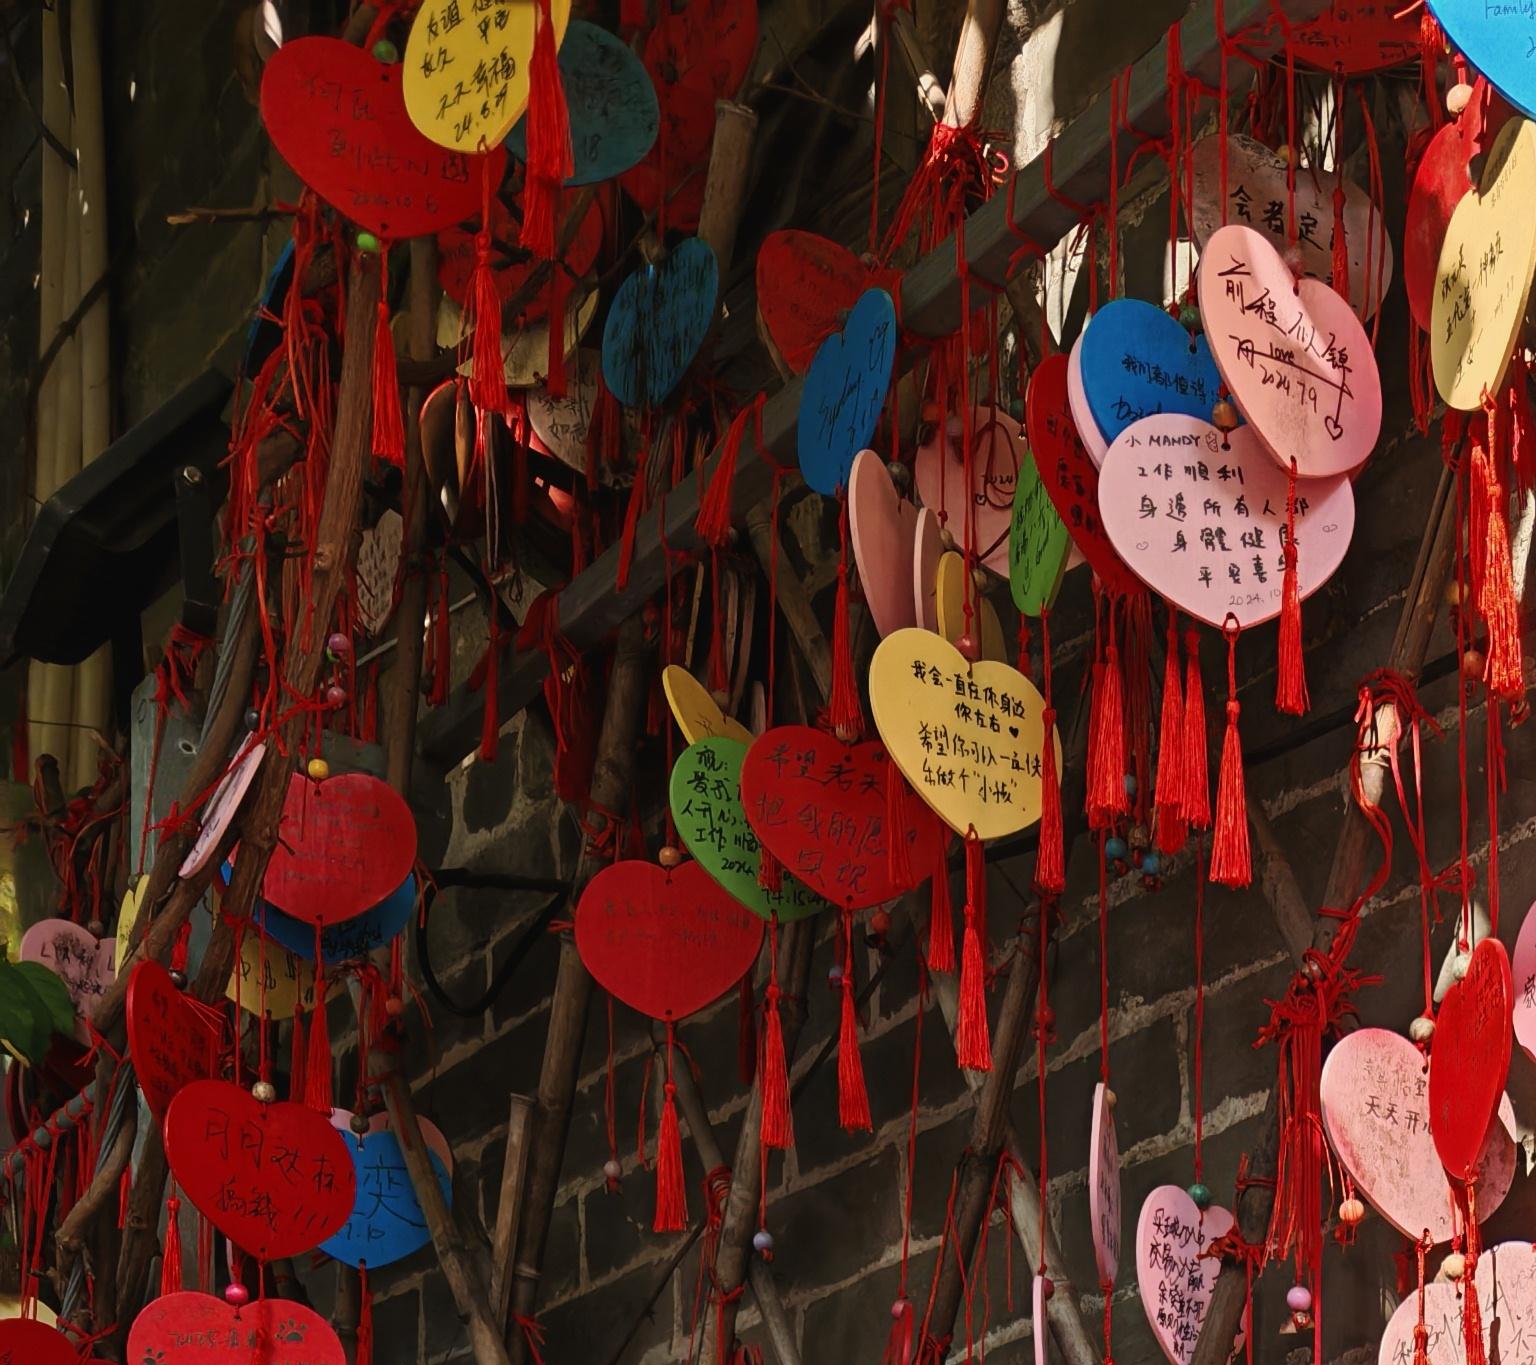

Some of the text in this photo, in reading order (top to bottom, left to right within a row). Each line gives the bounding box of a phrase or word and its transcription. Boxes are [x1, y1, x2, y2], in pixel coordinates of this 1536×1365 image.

[911, 659, 1026, 722] 我会一直在你身边
